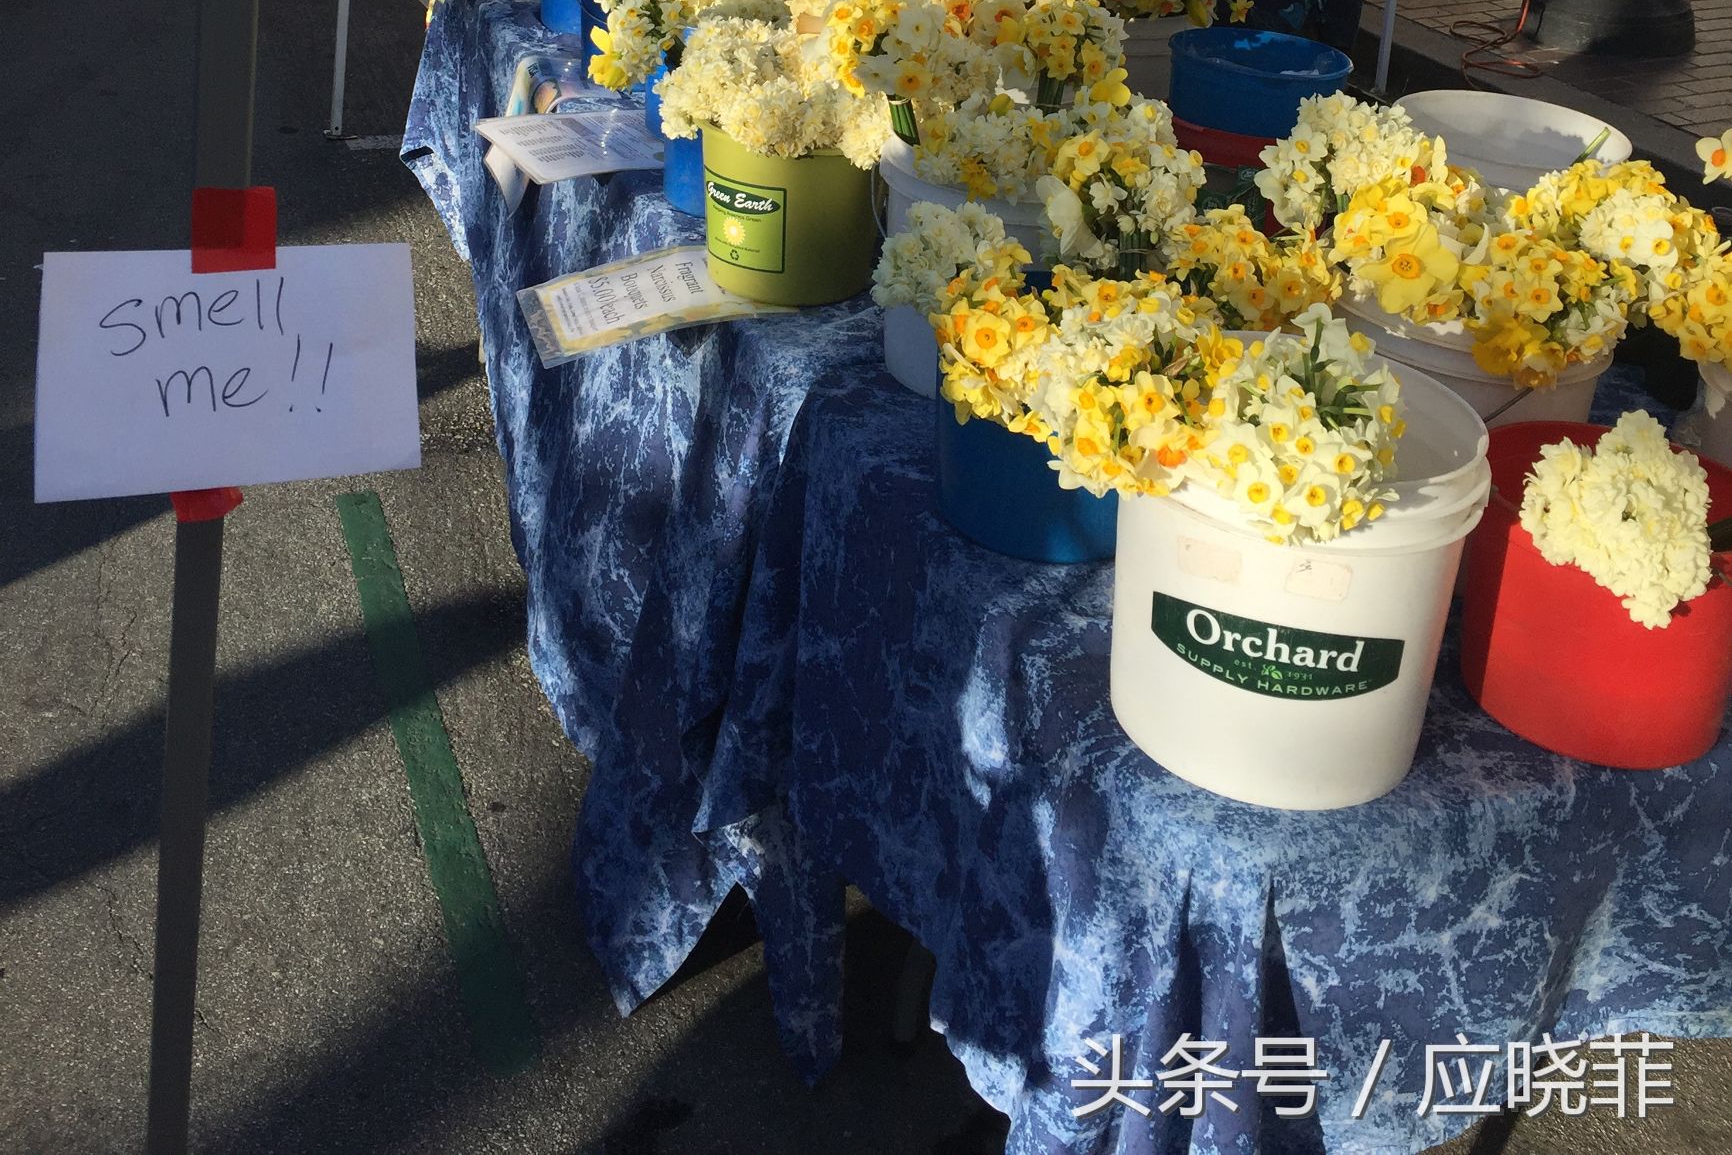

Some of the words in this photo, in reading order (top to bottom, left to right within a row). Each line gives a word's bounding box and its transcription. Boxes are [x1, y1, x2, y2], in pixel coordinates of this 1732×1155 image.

[708, 181, 731, 203] Green
[734, 193, 774, 211] Earth
[620, 272, 649, 309] Bouquets
[647, 264, 678, 303] Narcissus
[675, 261, 704, 295] Fragrant
[155, 334, 334, 417] me!!
[1186, 608, 1365, 673] Orchard
[1176, 642, 1248, 684] SUPPLY
[1257, 679, 1369, 696] HARDWARE
[1233, 658, 1258, 671] est.
